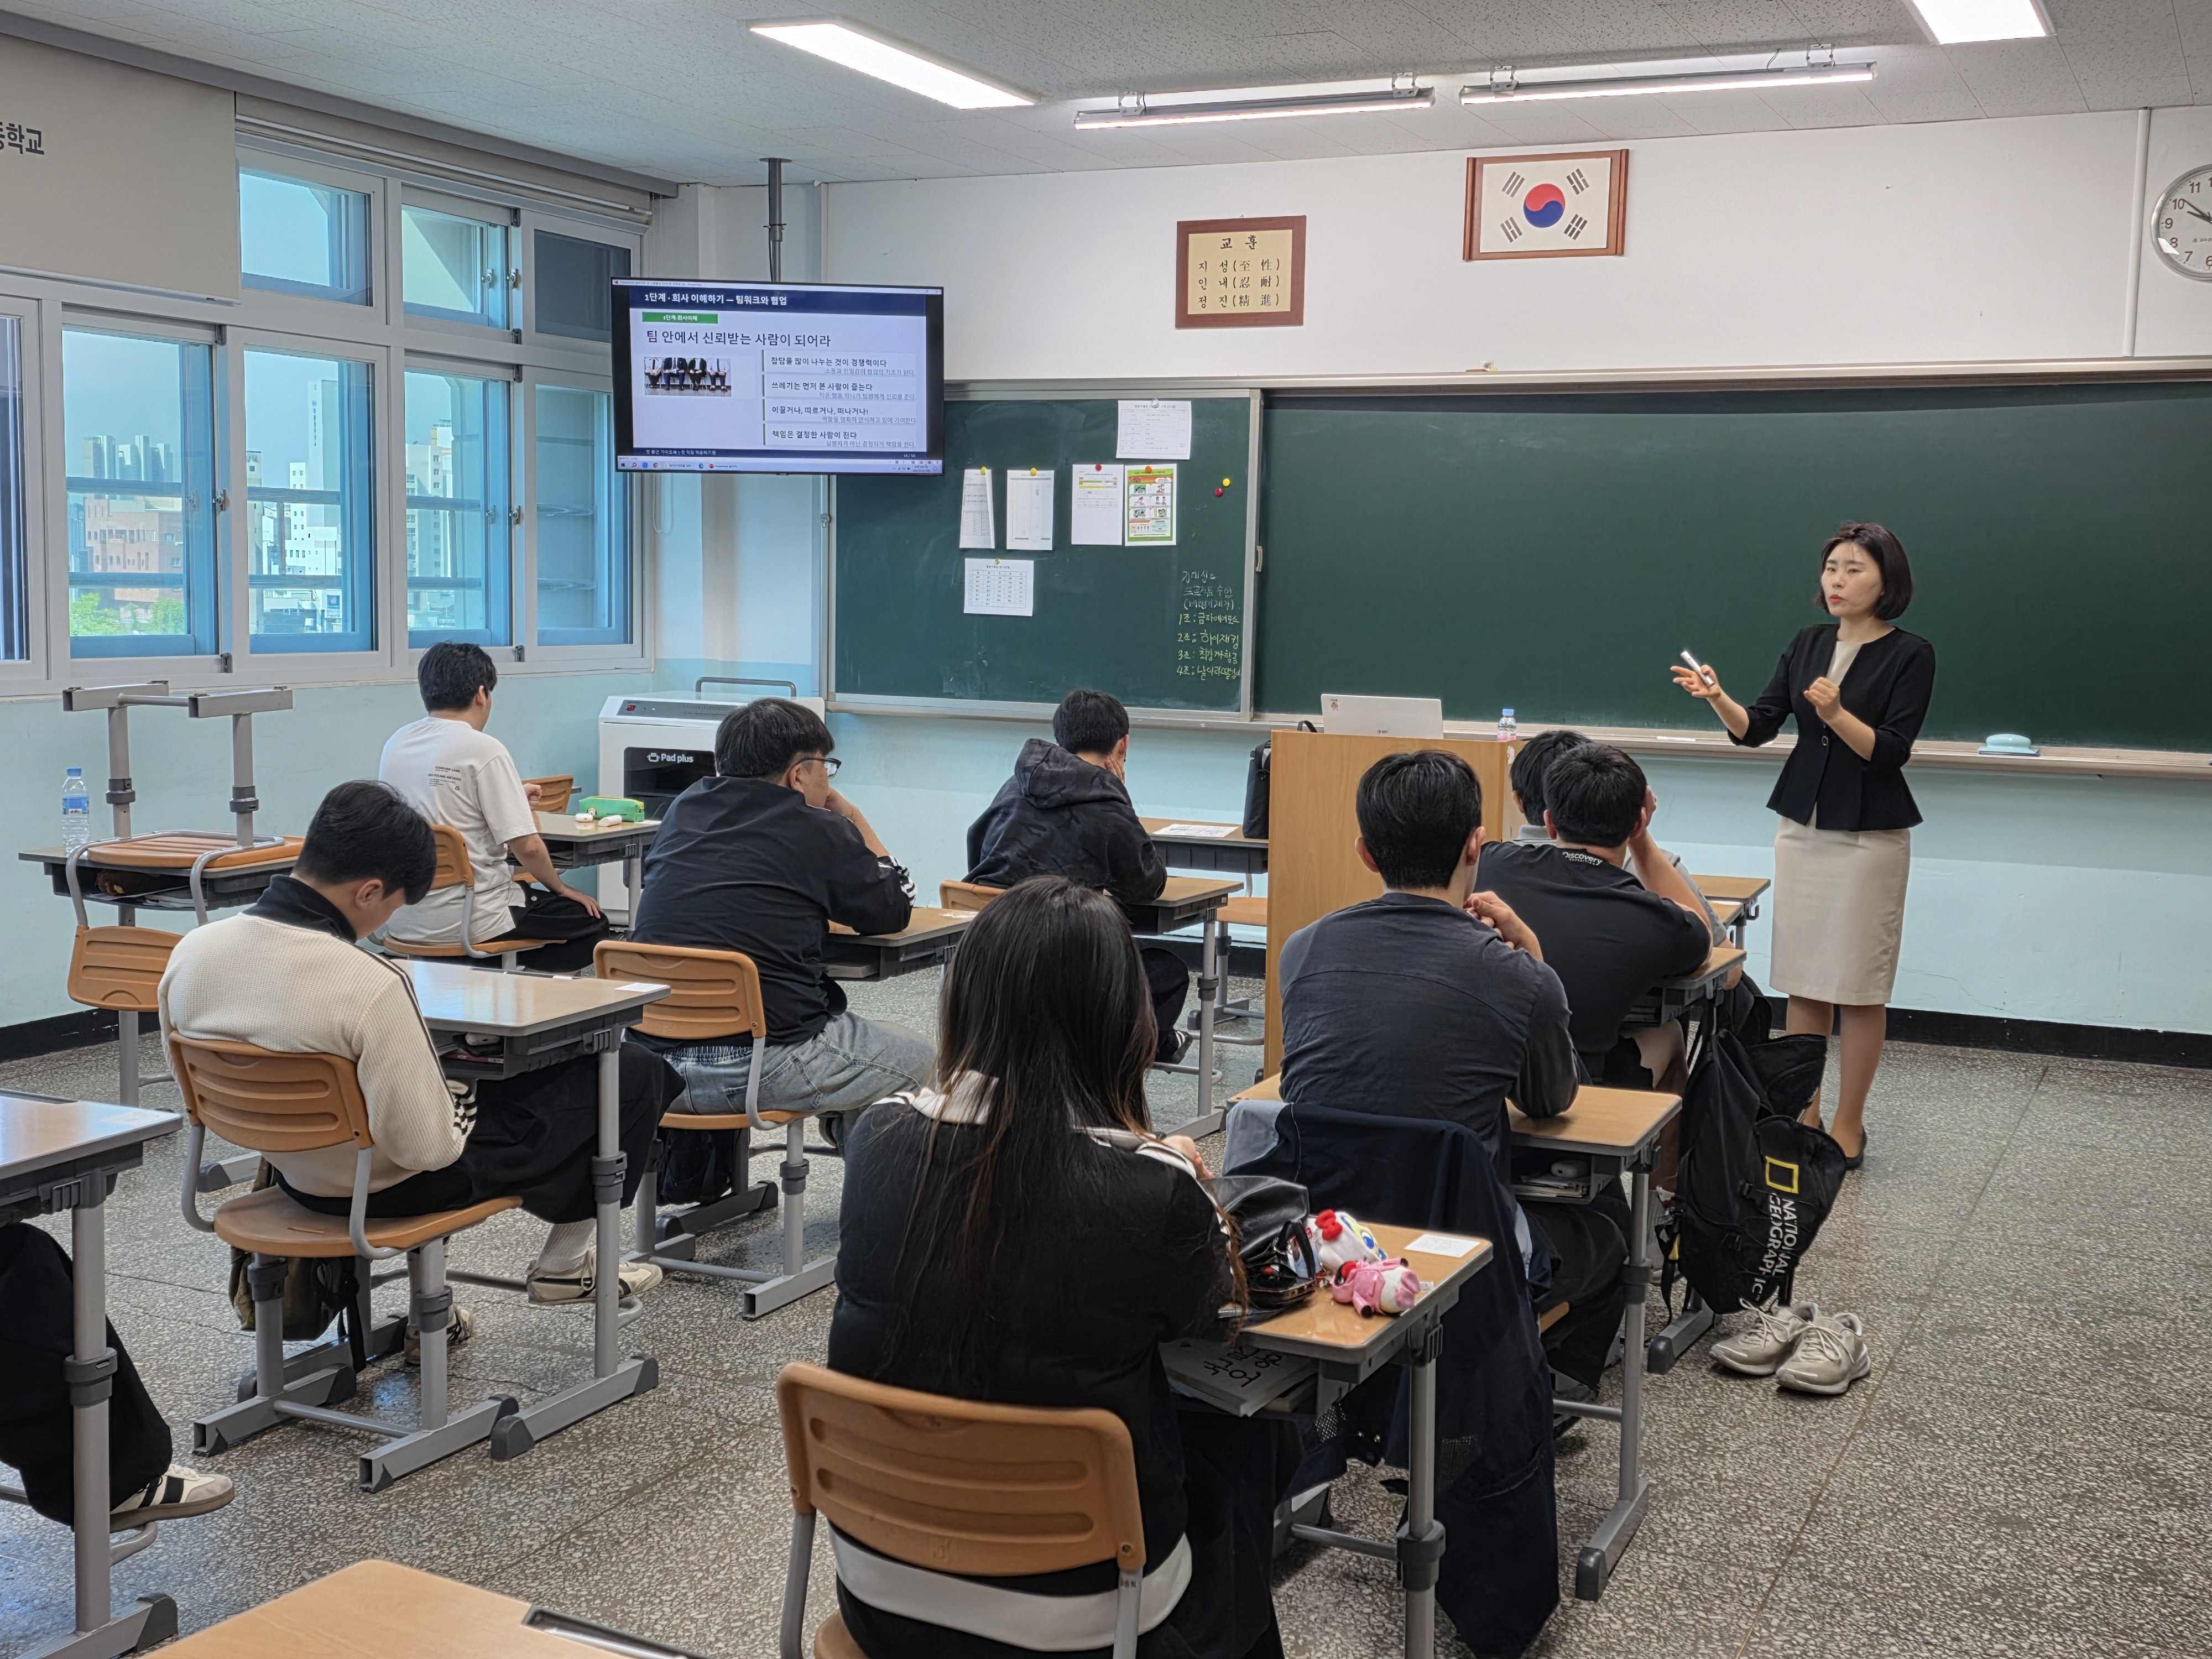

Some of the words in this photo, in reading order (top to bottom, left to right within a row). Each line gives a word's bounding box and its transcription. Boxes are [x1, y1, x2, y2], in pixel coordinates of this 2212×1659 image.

[0, 122, 44, 155] 학교
[2189, 182, 2200, 194] 11
[2172, 198, 2185, 210] 10
[2164, 218, 2173, 229] 9
[2169, 237, 2178, 248] 8
[2184, 251, 2193, 262] 7
[2205, 255, 2212, 267] 6
[645, 294, 665, 302] 1단계
[672, 294, 689, 302] 회사
[691, 294, 724, 304] 이해하기
[735, 296, 769, 305] 팀워크와
[770, 296, 786, 305] 협업
[647, 331, 657, 343] 팀
[662, 331, 698, 344] 안에서
[703, 331, 752, 345] 신뢰받는
[755, 333, 790, 346] 사람이
[794, 334, 831, 347] 되어라
[795, 357, 808, 366] 많이
[771, 382, 800, 390] 쓰레기는
[803, 382, 816, 390] 먼저
[772, 406, 802, 415] 이끌거나,
[1216, 585, 1233, 598] 수업
[661, 753, 676, 762] Pad
[677, 754, 693, 763] plus
